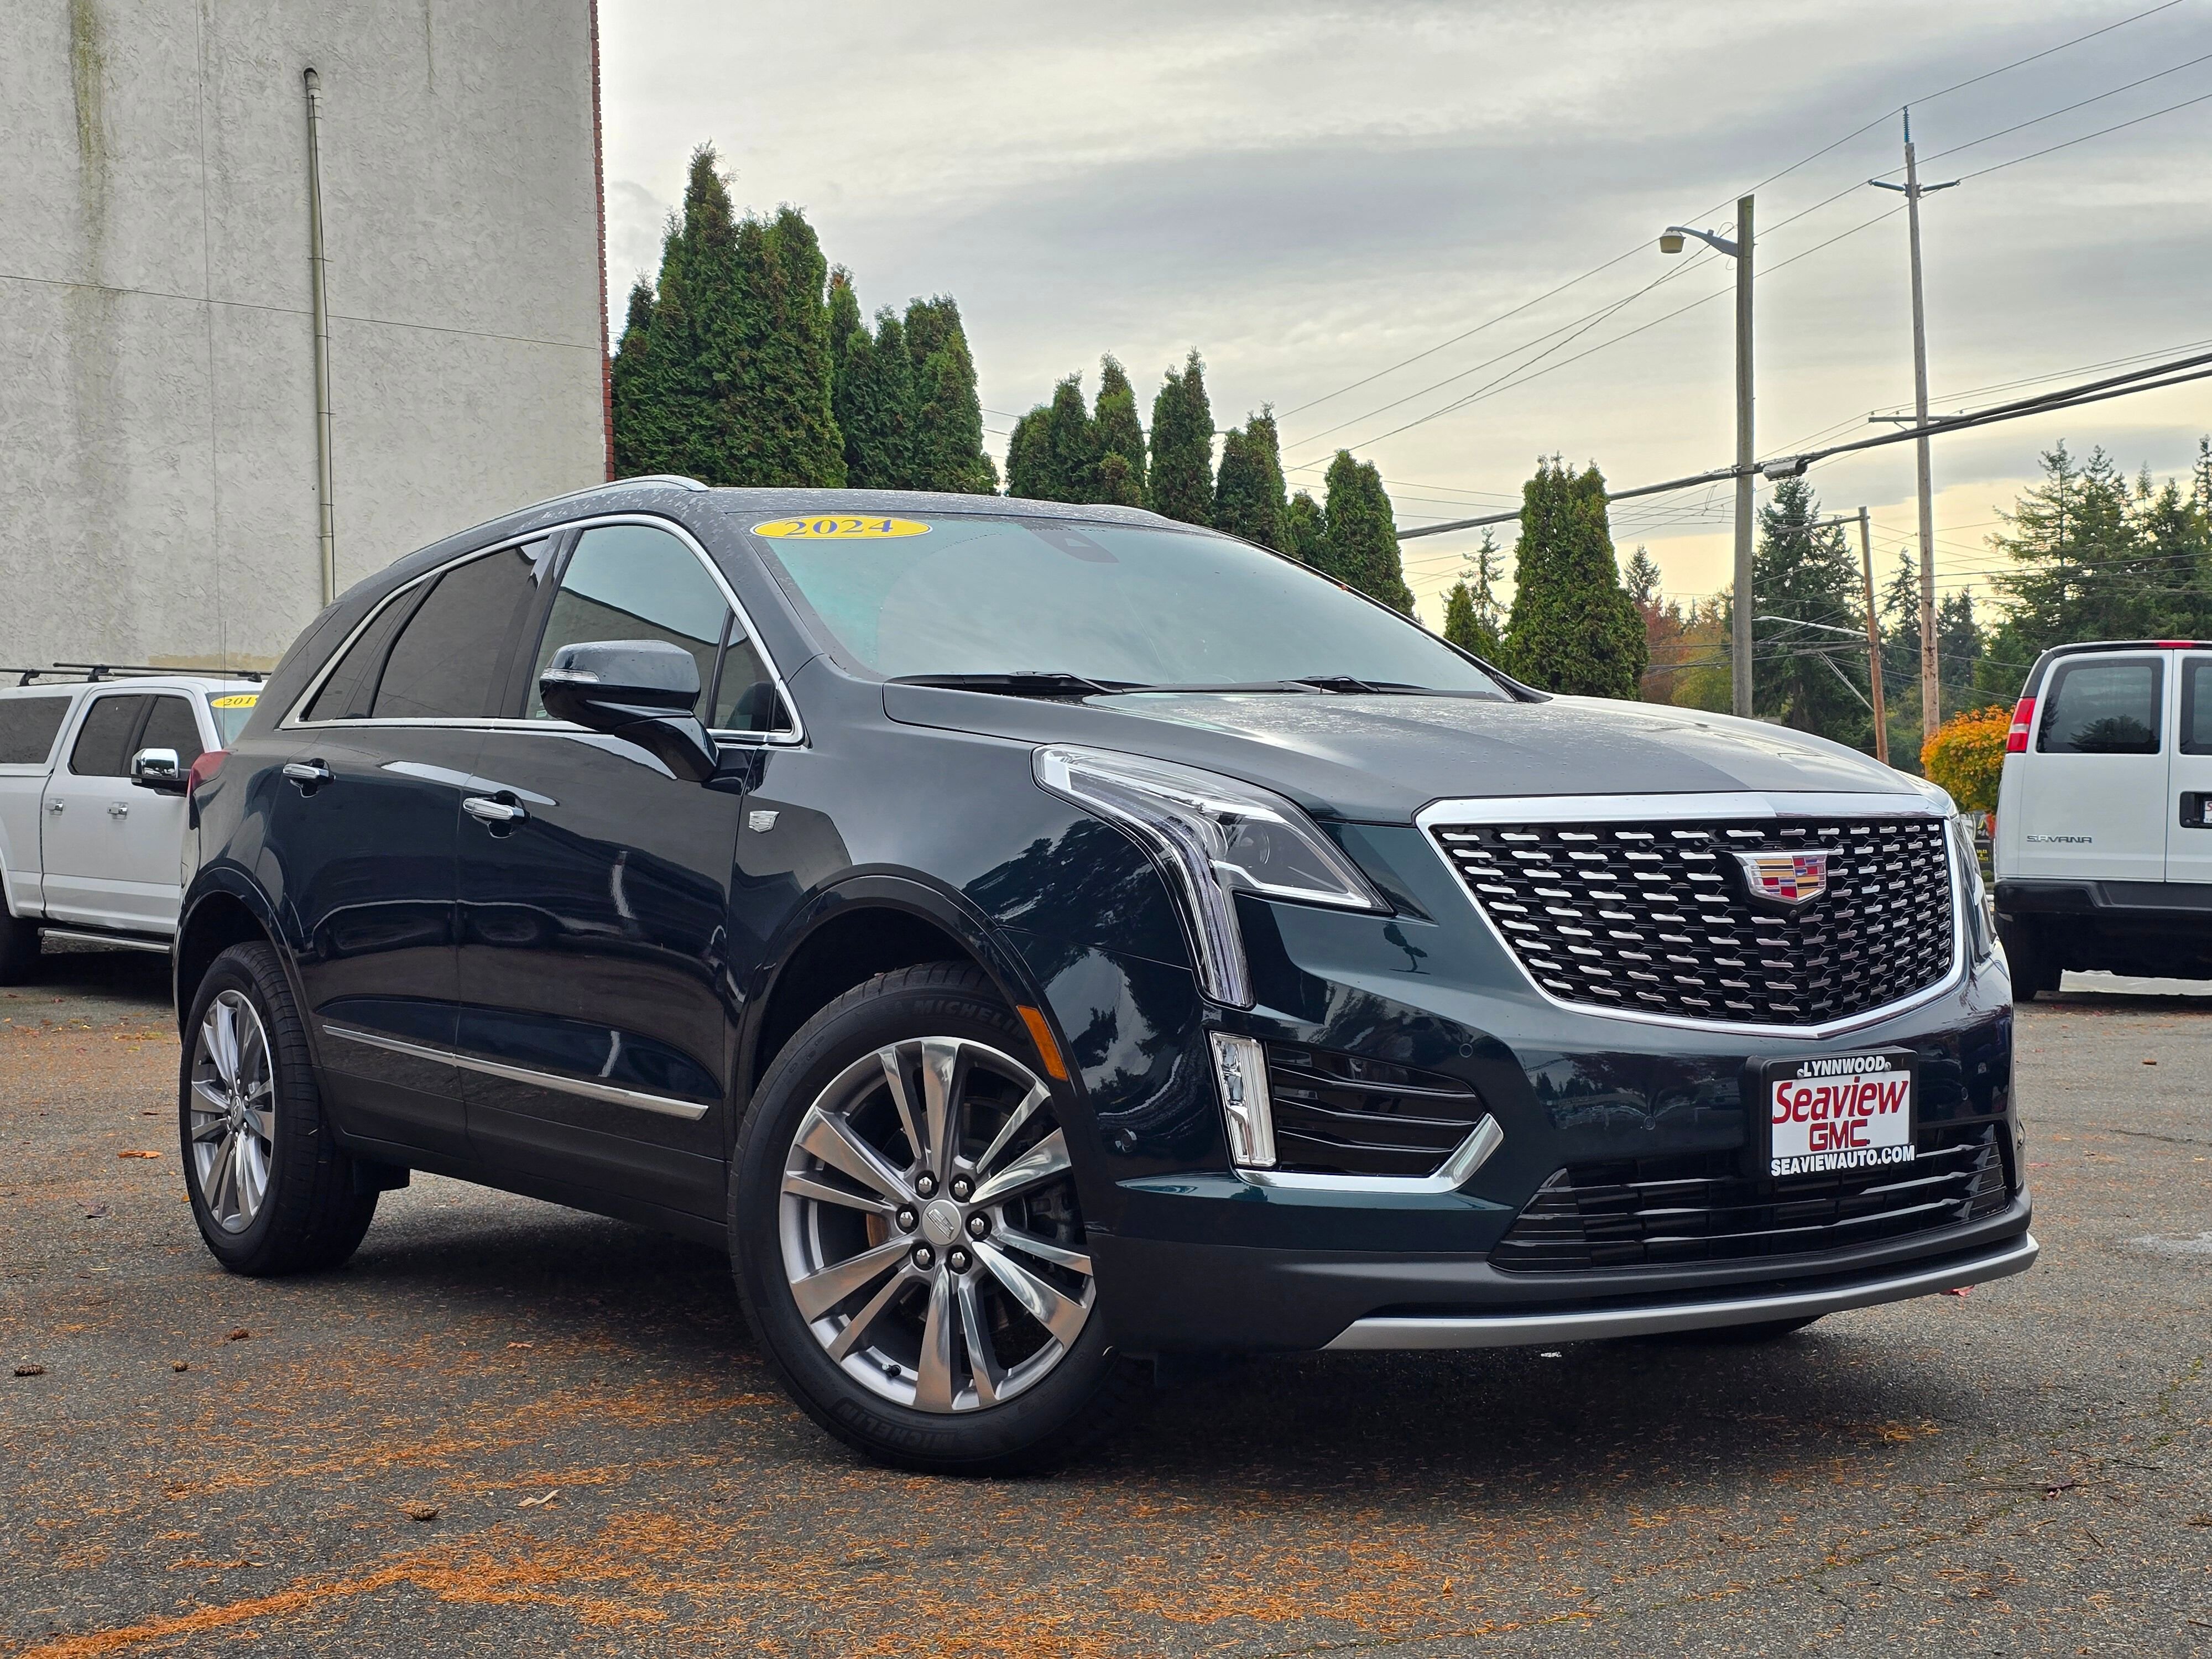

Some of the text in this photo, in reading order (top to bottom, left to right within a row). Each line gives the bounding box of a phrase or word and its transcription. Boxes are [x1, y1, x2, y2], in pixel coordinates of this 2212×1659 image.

[784, 519, 893, 536] 2024
[224, 697, 257, 706] 201
[2026, 834, 2093, 843] SAVANA
[1804, 1056, 1885, 1077] LYNNWOOD
[1772, 1076, 1908, 1124] Seaview
[1809, 1119, 1869, 1151] GMC
[1771, 1145, 1914, 1176] SEAVIEWAUTO.COM
